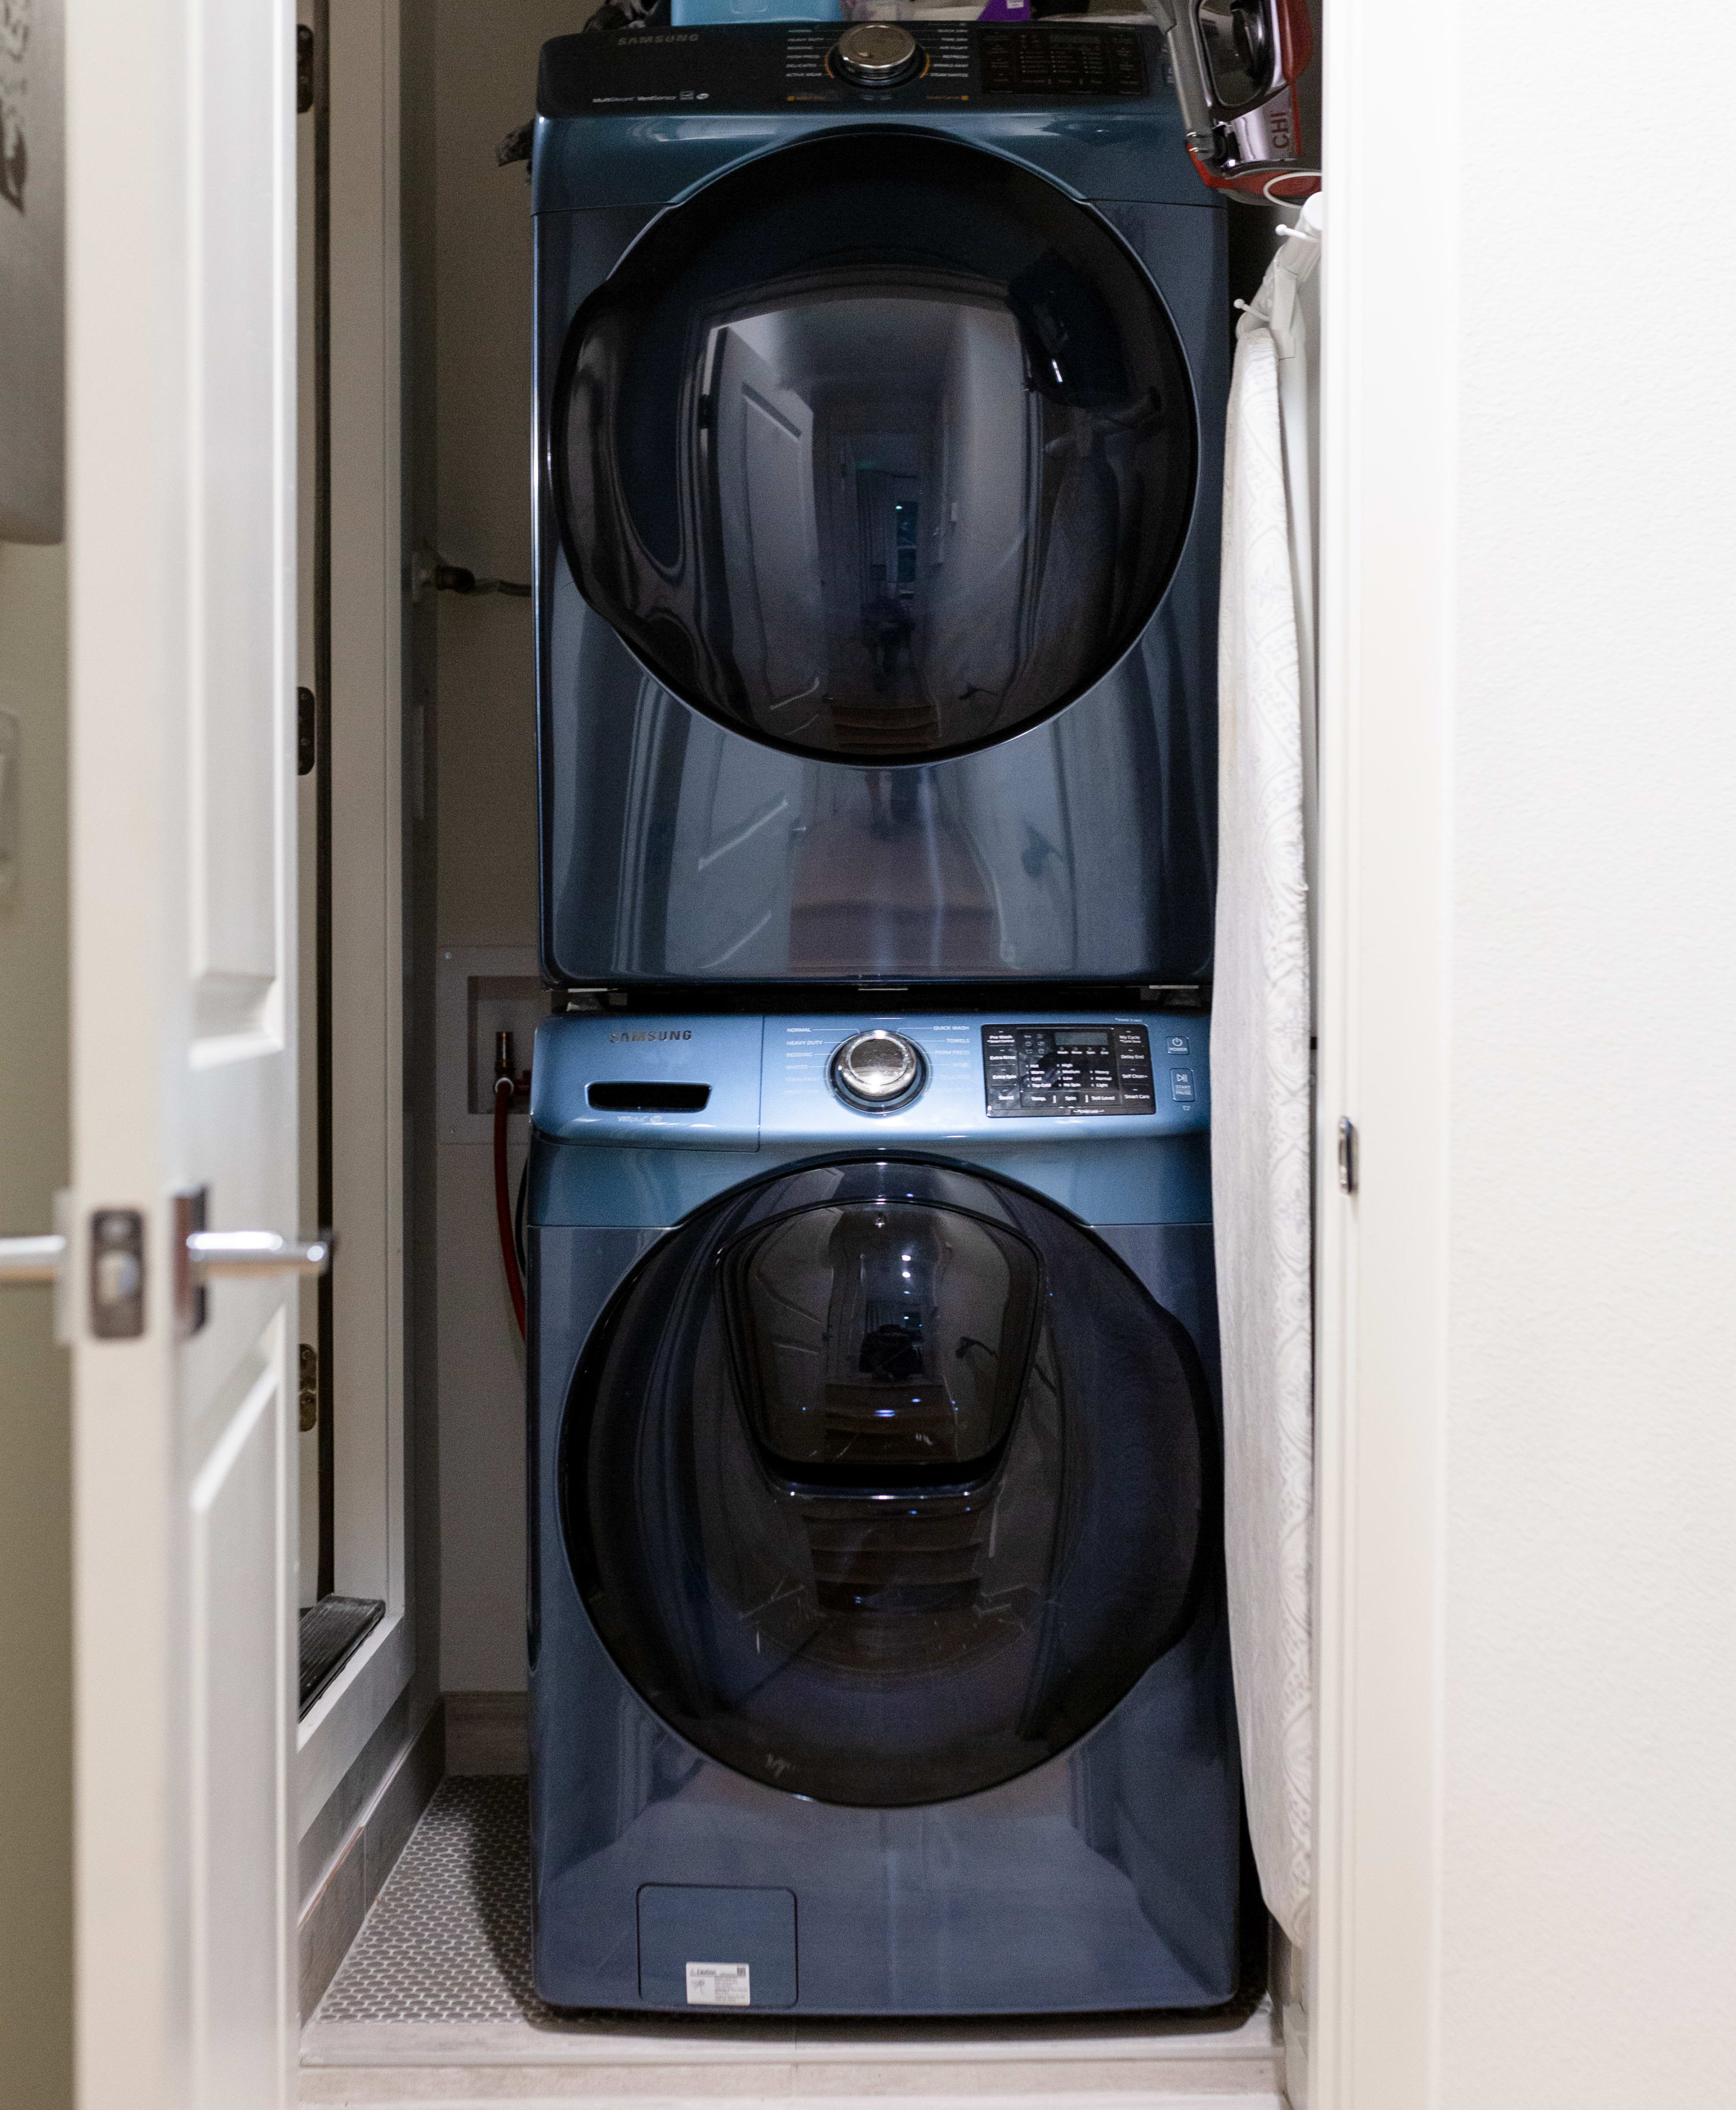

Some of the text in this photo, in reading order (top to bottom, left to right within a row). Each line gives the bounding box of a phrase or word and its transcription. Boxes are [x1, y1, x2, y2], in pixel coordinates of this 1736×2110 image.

[617, 34, 699, 46] SAMSUNG
[1270, 112, 1290, 149] CHI
[610, 1030, 692, 1043] SAMSUNG
